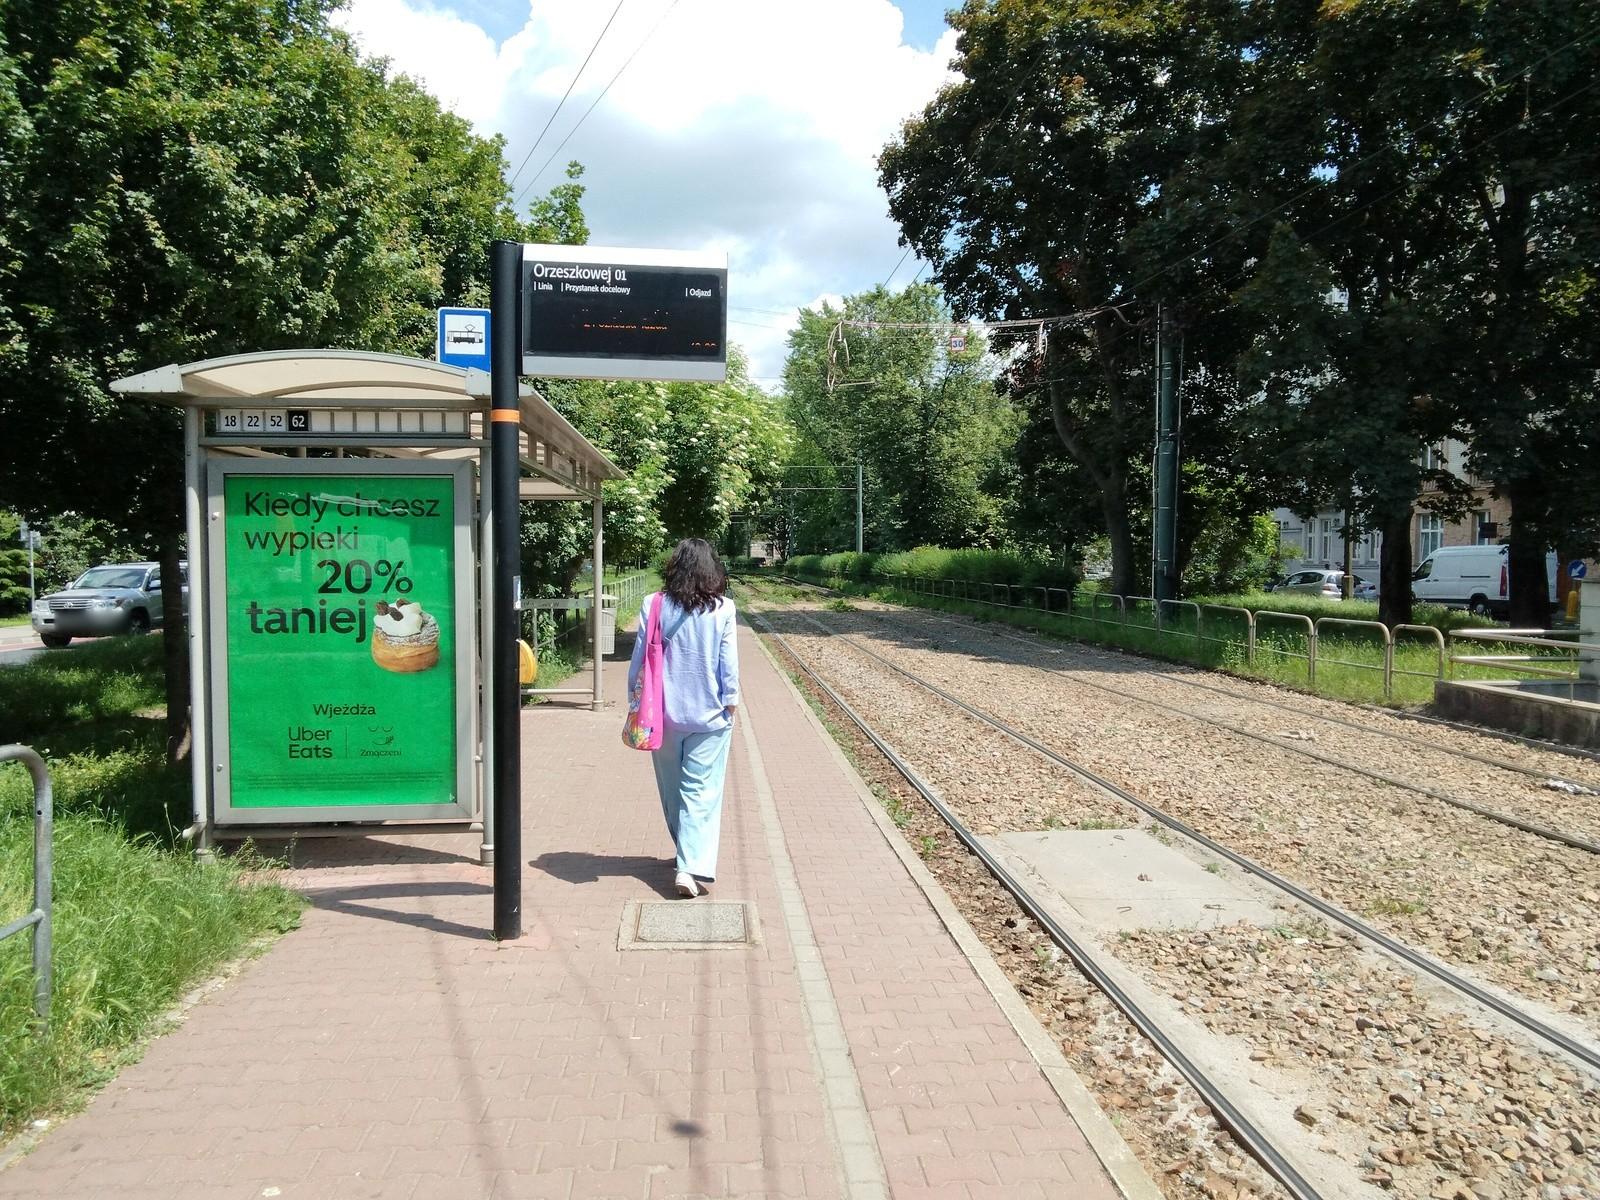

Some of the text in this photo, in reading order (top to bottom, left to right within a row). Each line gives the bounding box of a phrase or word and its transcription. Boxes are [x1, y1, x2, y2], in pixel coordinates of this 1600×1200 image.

[533, 263, 627, 284] Orzeszkowej 01
[538, 282, 553, 291] Linia
[565, 283, 631, 295] Przystanek docelowy
[689, 288, 712, 298] Odjazd
[224, 415, 305, 428] 18 22 52 62
[245, 491, 441, 523] Kiedy chcesz
[244, 525, 359, 556] wypieki
[317, 559, 414, 594] 20%
[246, 598, 367, 643] taniej
[313, 703, 377, 719] Wjeżdża
[287, 726, 333, 742] Uber
[288, 744, 334, 759] Eats
